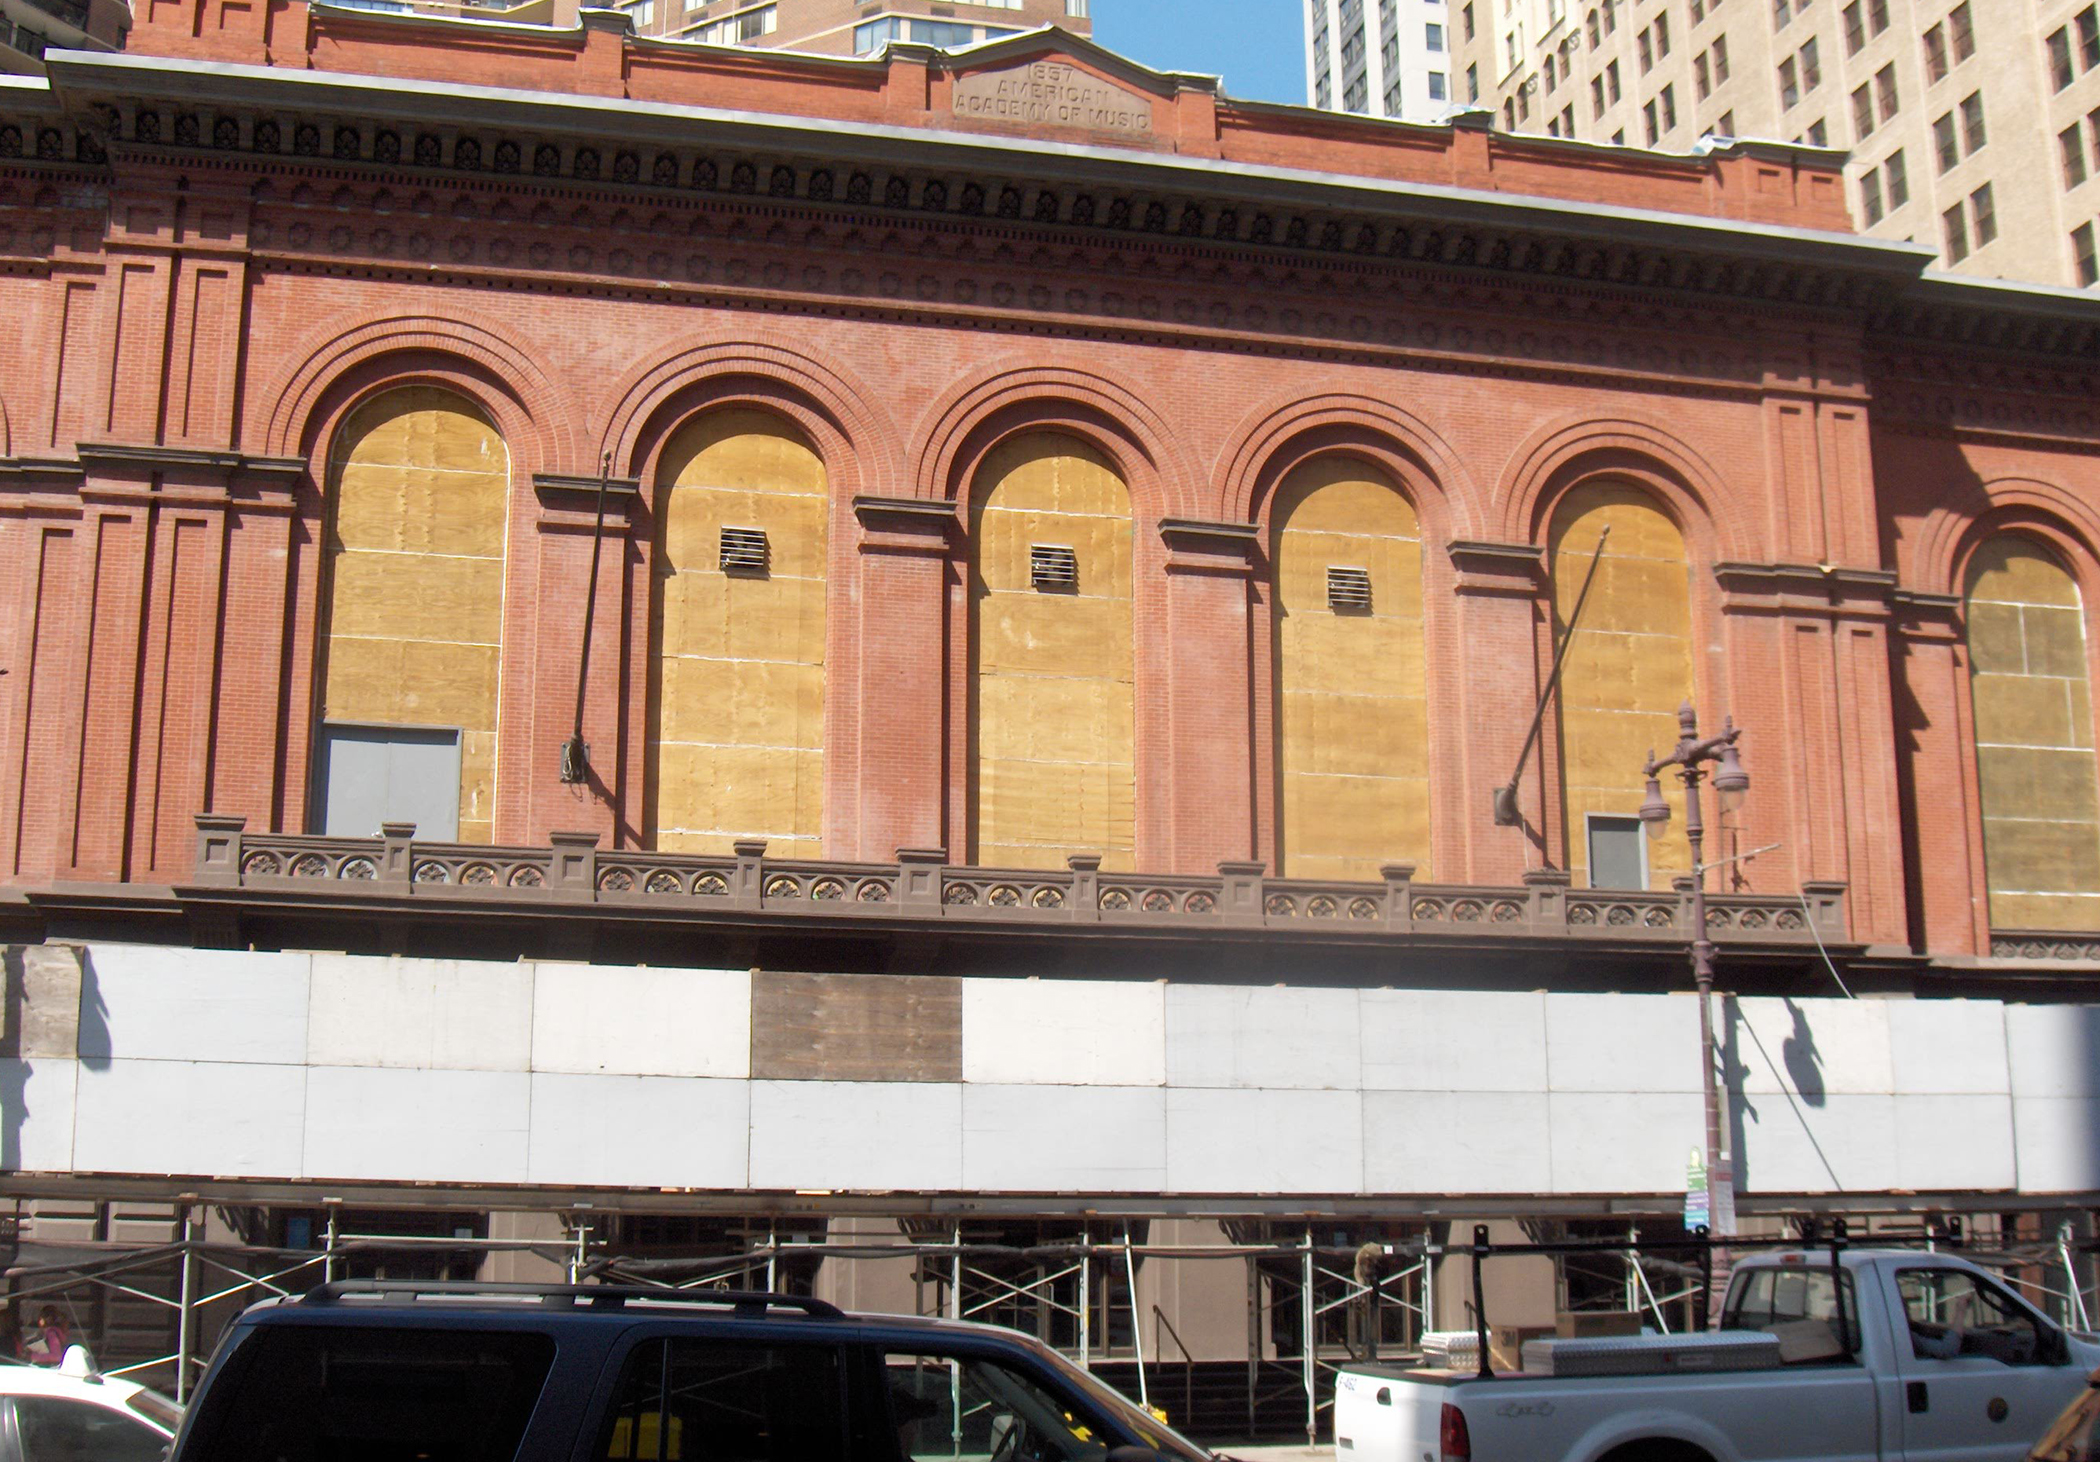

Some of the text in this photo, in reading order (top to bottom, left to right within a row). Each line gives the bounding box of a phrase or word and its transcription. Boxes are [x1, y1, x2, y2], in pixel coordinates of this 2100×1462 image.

[1027, 63, 1074, 82] 1857
[997, 80, 1109, 105] AMERICAN
[955, 94, 1148, 130] ACADEMY OF MUSIC
